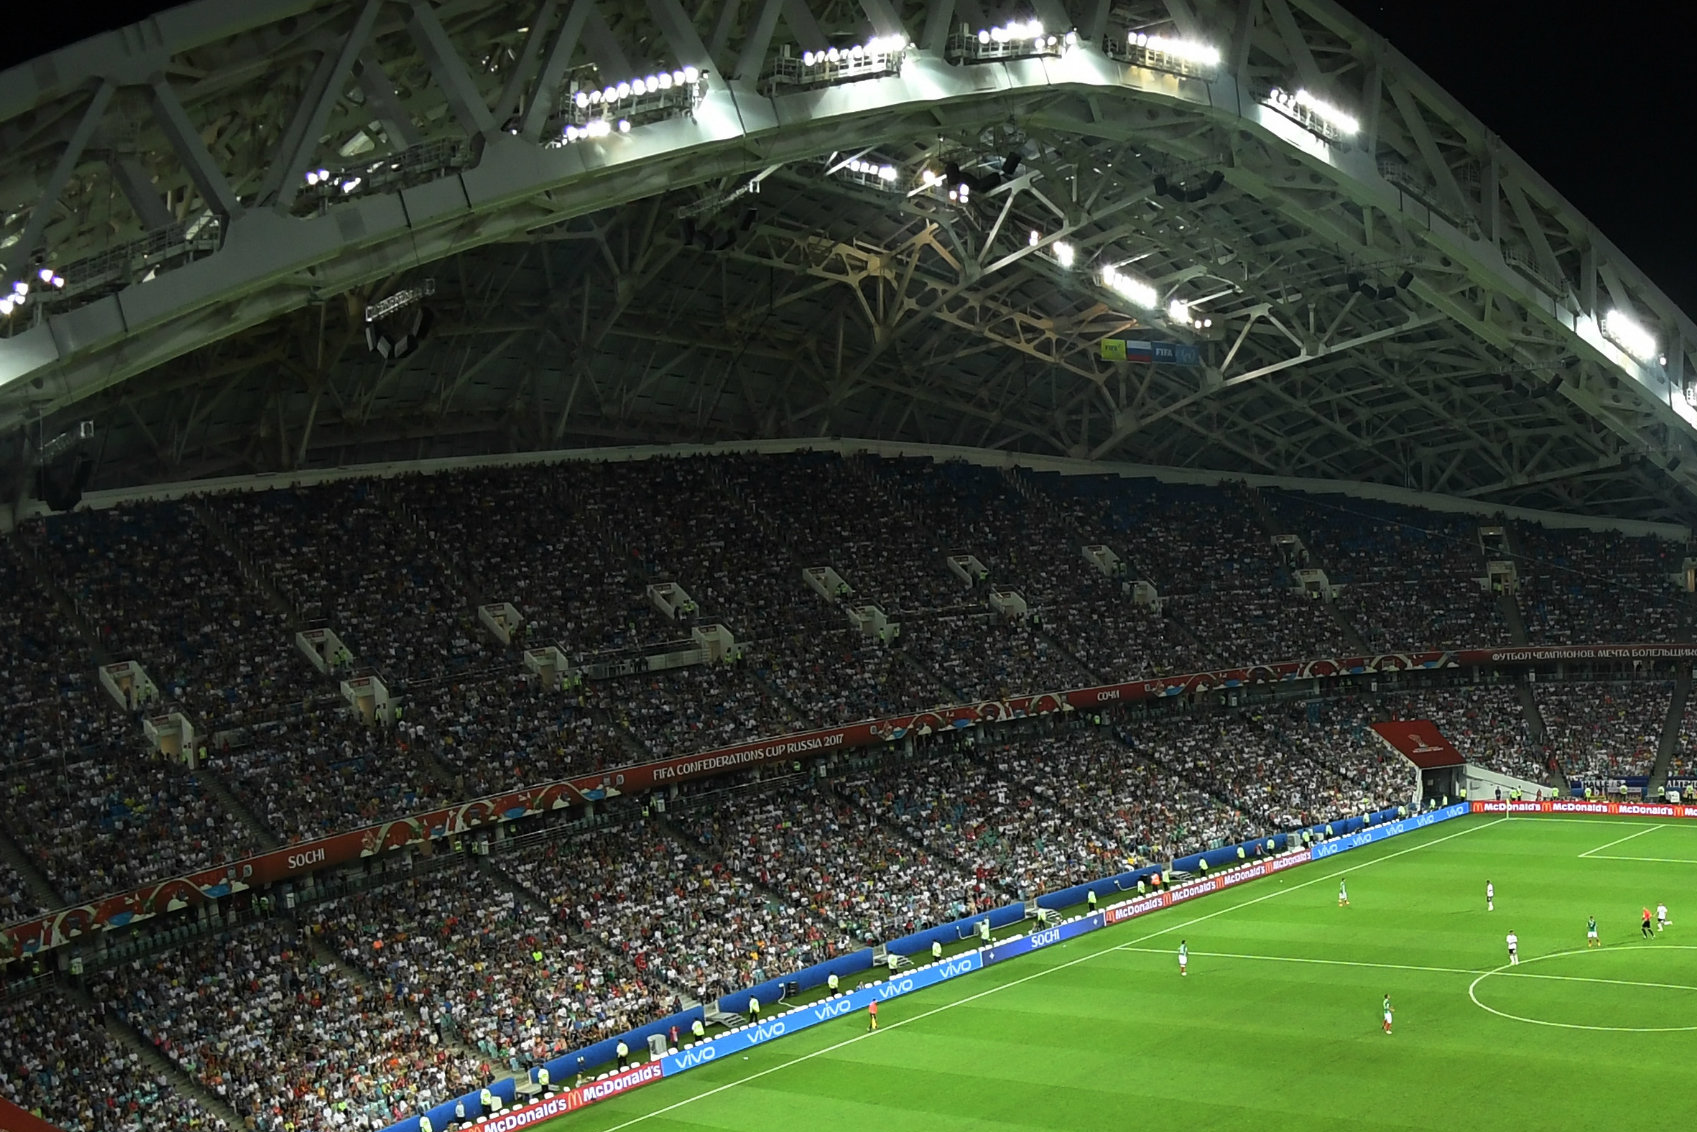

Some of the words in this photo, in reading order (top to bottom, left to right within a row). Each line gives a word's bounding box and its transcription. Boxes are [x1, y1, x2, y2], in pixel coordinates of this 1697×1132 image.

[1155, 348, 1172, 357] FIFA
[1597, 650, 1630, 658] МЕЧТА
[1098, 690, 1120, 701] СОЧИ
[653, 767, 676, 780] FIFA
[676, 749, 764, 775] CONFEDERATIONS
[766, 744, 786, 758] CUP
[787, 739, 822, 753] RUSSIA
[824, 734, 844, 746] 2017
[1484, 802, 1541, 812] McDonald's
[1552, 803, 1608, 813] McDonald's
[1618, 804, 1674, 816] McDonald's
[288, 848, 325, 868] SOCHI
[1116, 896, 1163, 920] McDonald's
[1172, 880, 1216, 902] McDonald's
[1224, 864, 1266, 886] McDonald's
[1273, 852, 1312, 870] McDonald's
[1031, 930, 1060, 948] SOCHI
[582, 1064, 662, 1102] McDonald's
